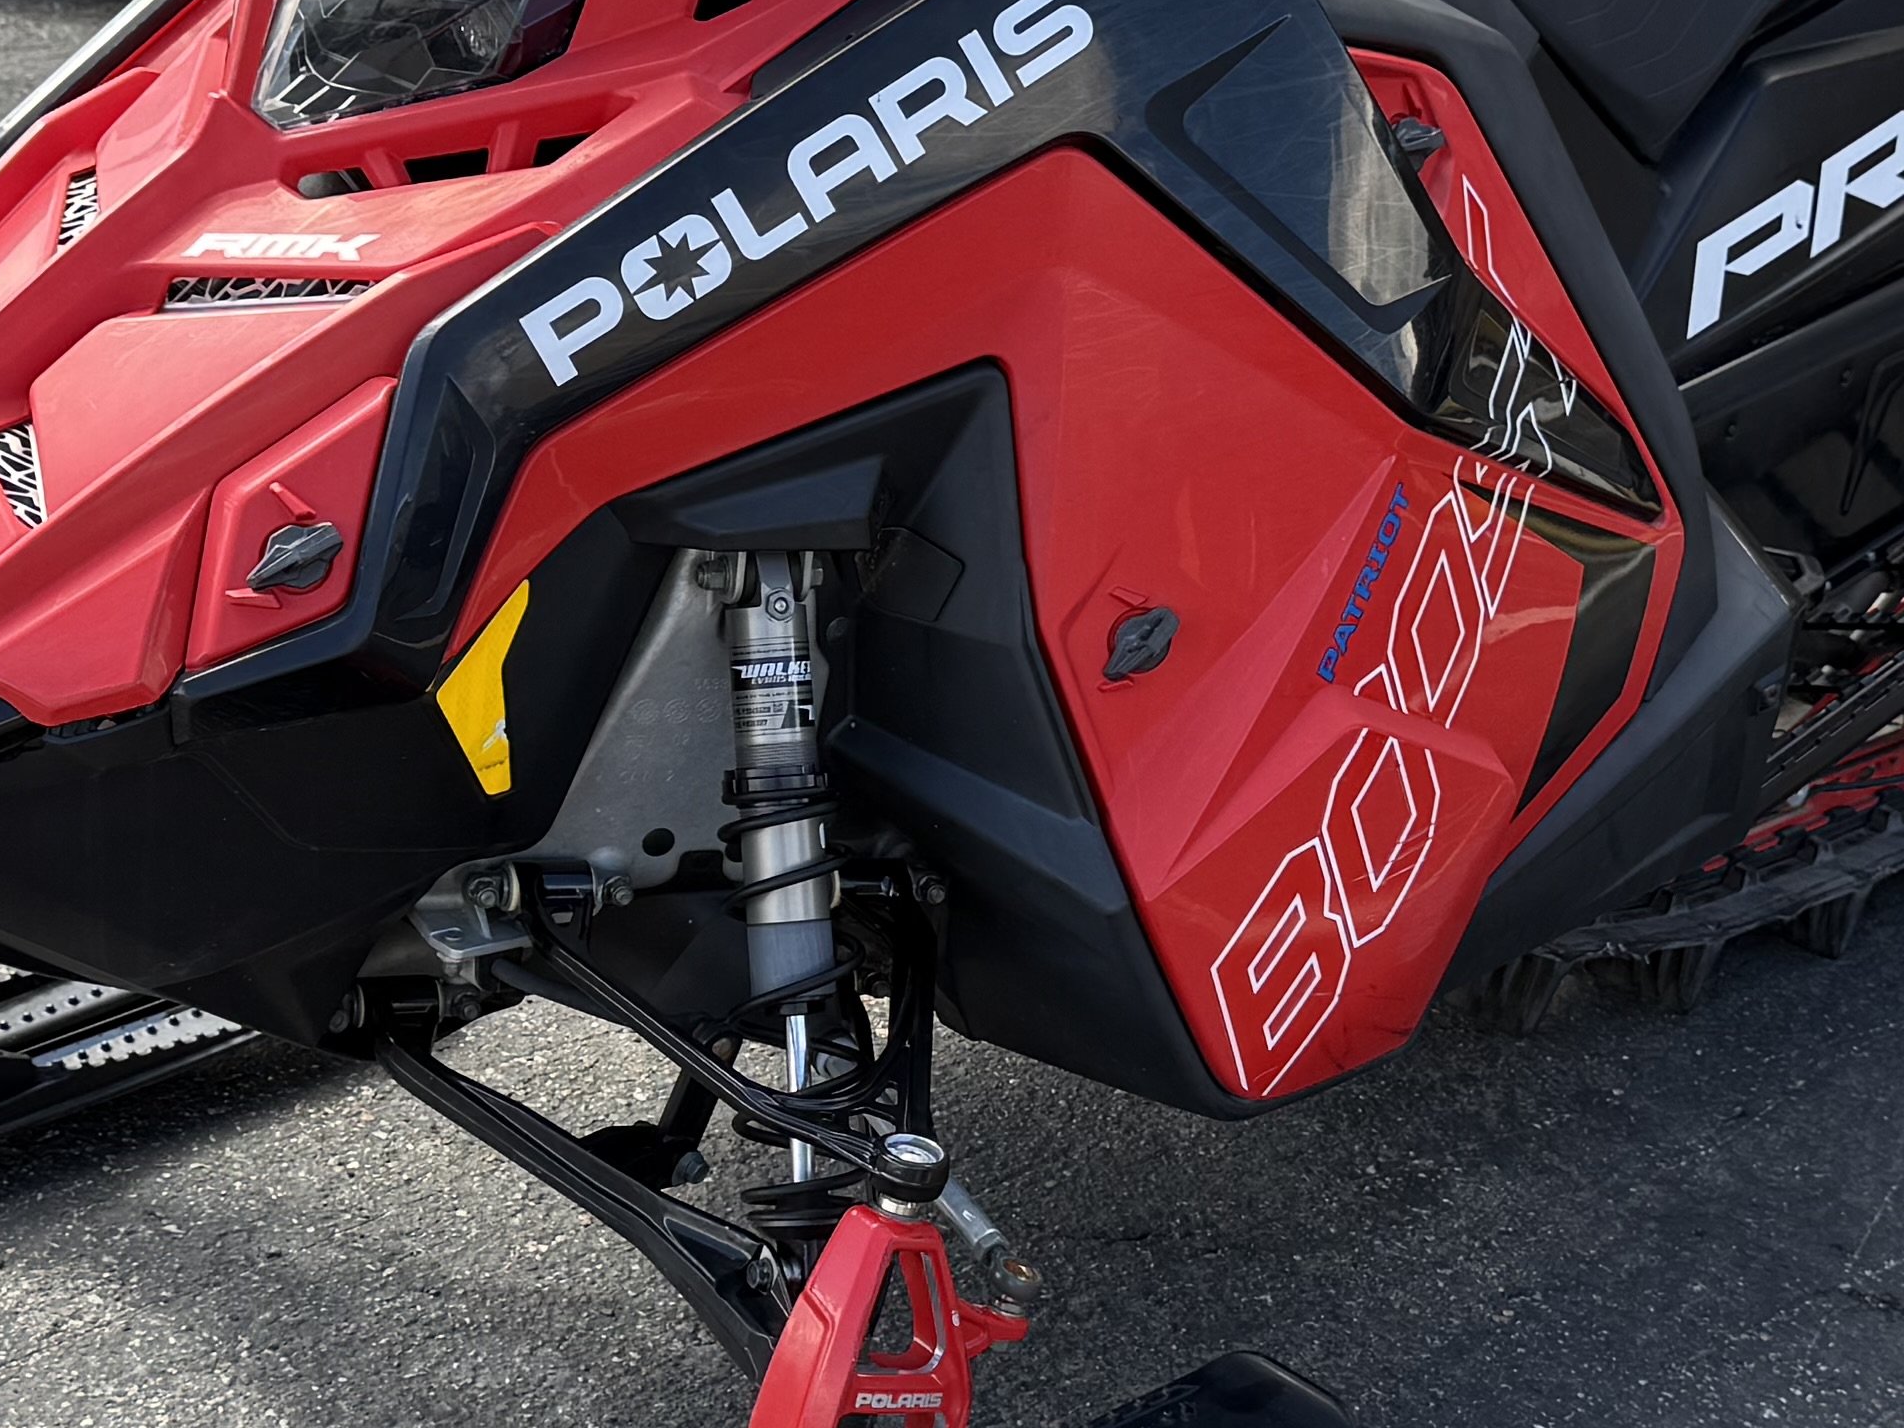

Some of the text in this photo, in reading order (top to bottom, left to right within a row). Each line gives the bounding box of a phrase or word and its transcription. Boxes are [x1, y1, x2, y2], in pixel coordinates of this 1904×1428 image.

[179, 232, 382, 262] RMK
[1316, 481, 1410, 684] PATRIOT
[854, 1392, 944, 1409] POLARIS
